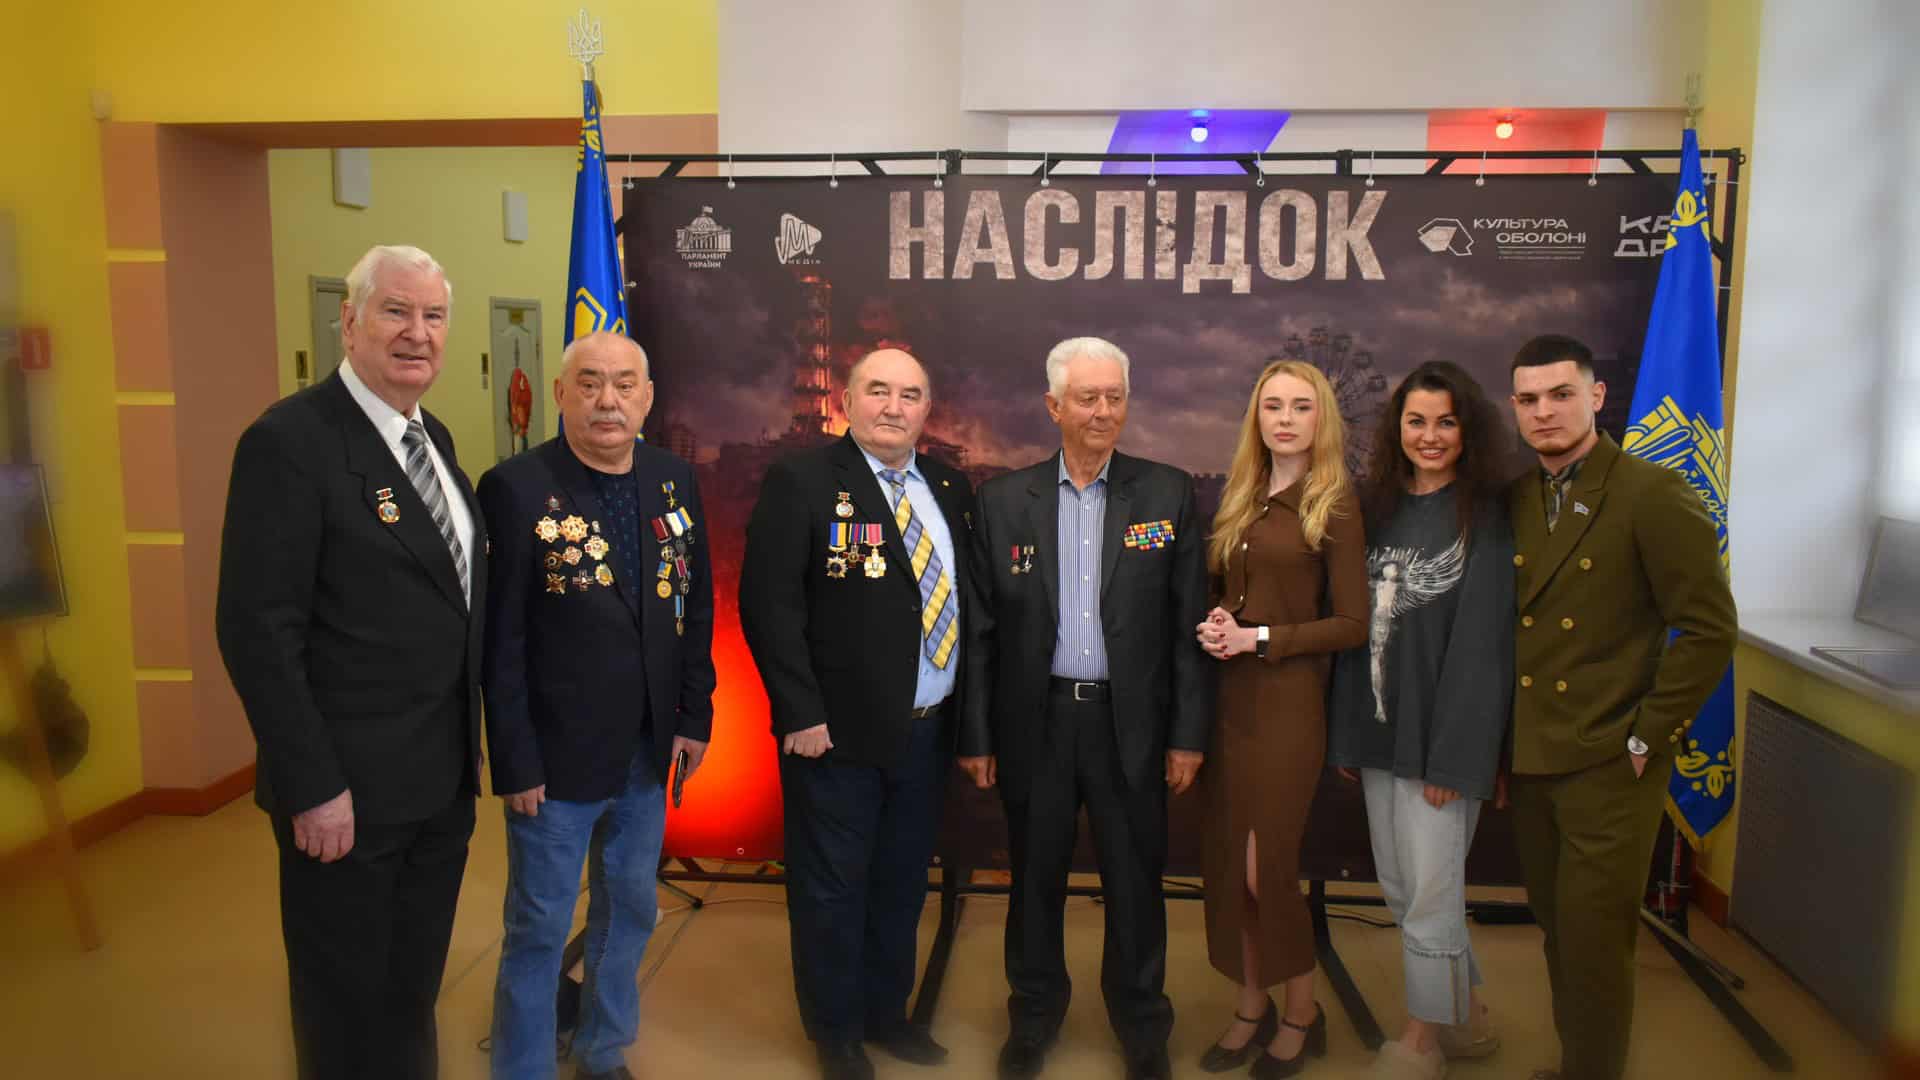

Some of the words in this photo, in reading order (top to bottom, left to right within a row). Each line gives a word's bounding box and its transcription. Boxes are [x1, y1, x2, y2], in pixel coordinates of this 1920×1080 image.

[1473, 218, 1569, 229] КУЛЬТУРА
[888, 188, 1388, 294] НАСЛІДОК
[1495, 231, 1587, 244] ОБОЛОНІ
[681, 252, 727, 261] ПАРЛАМЕНТ
[687, 259, 721, 270] УКРАЇНИ
